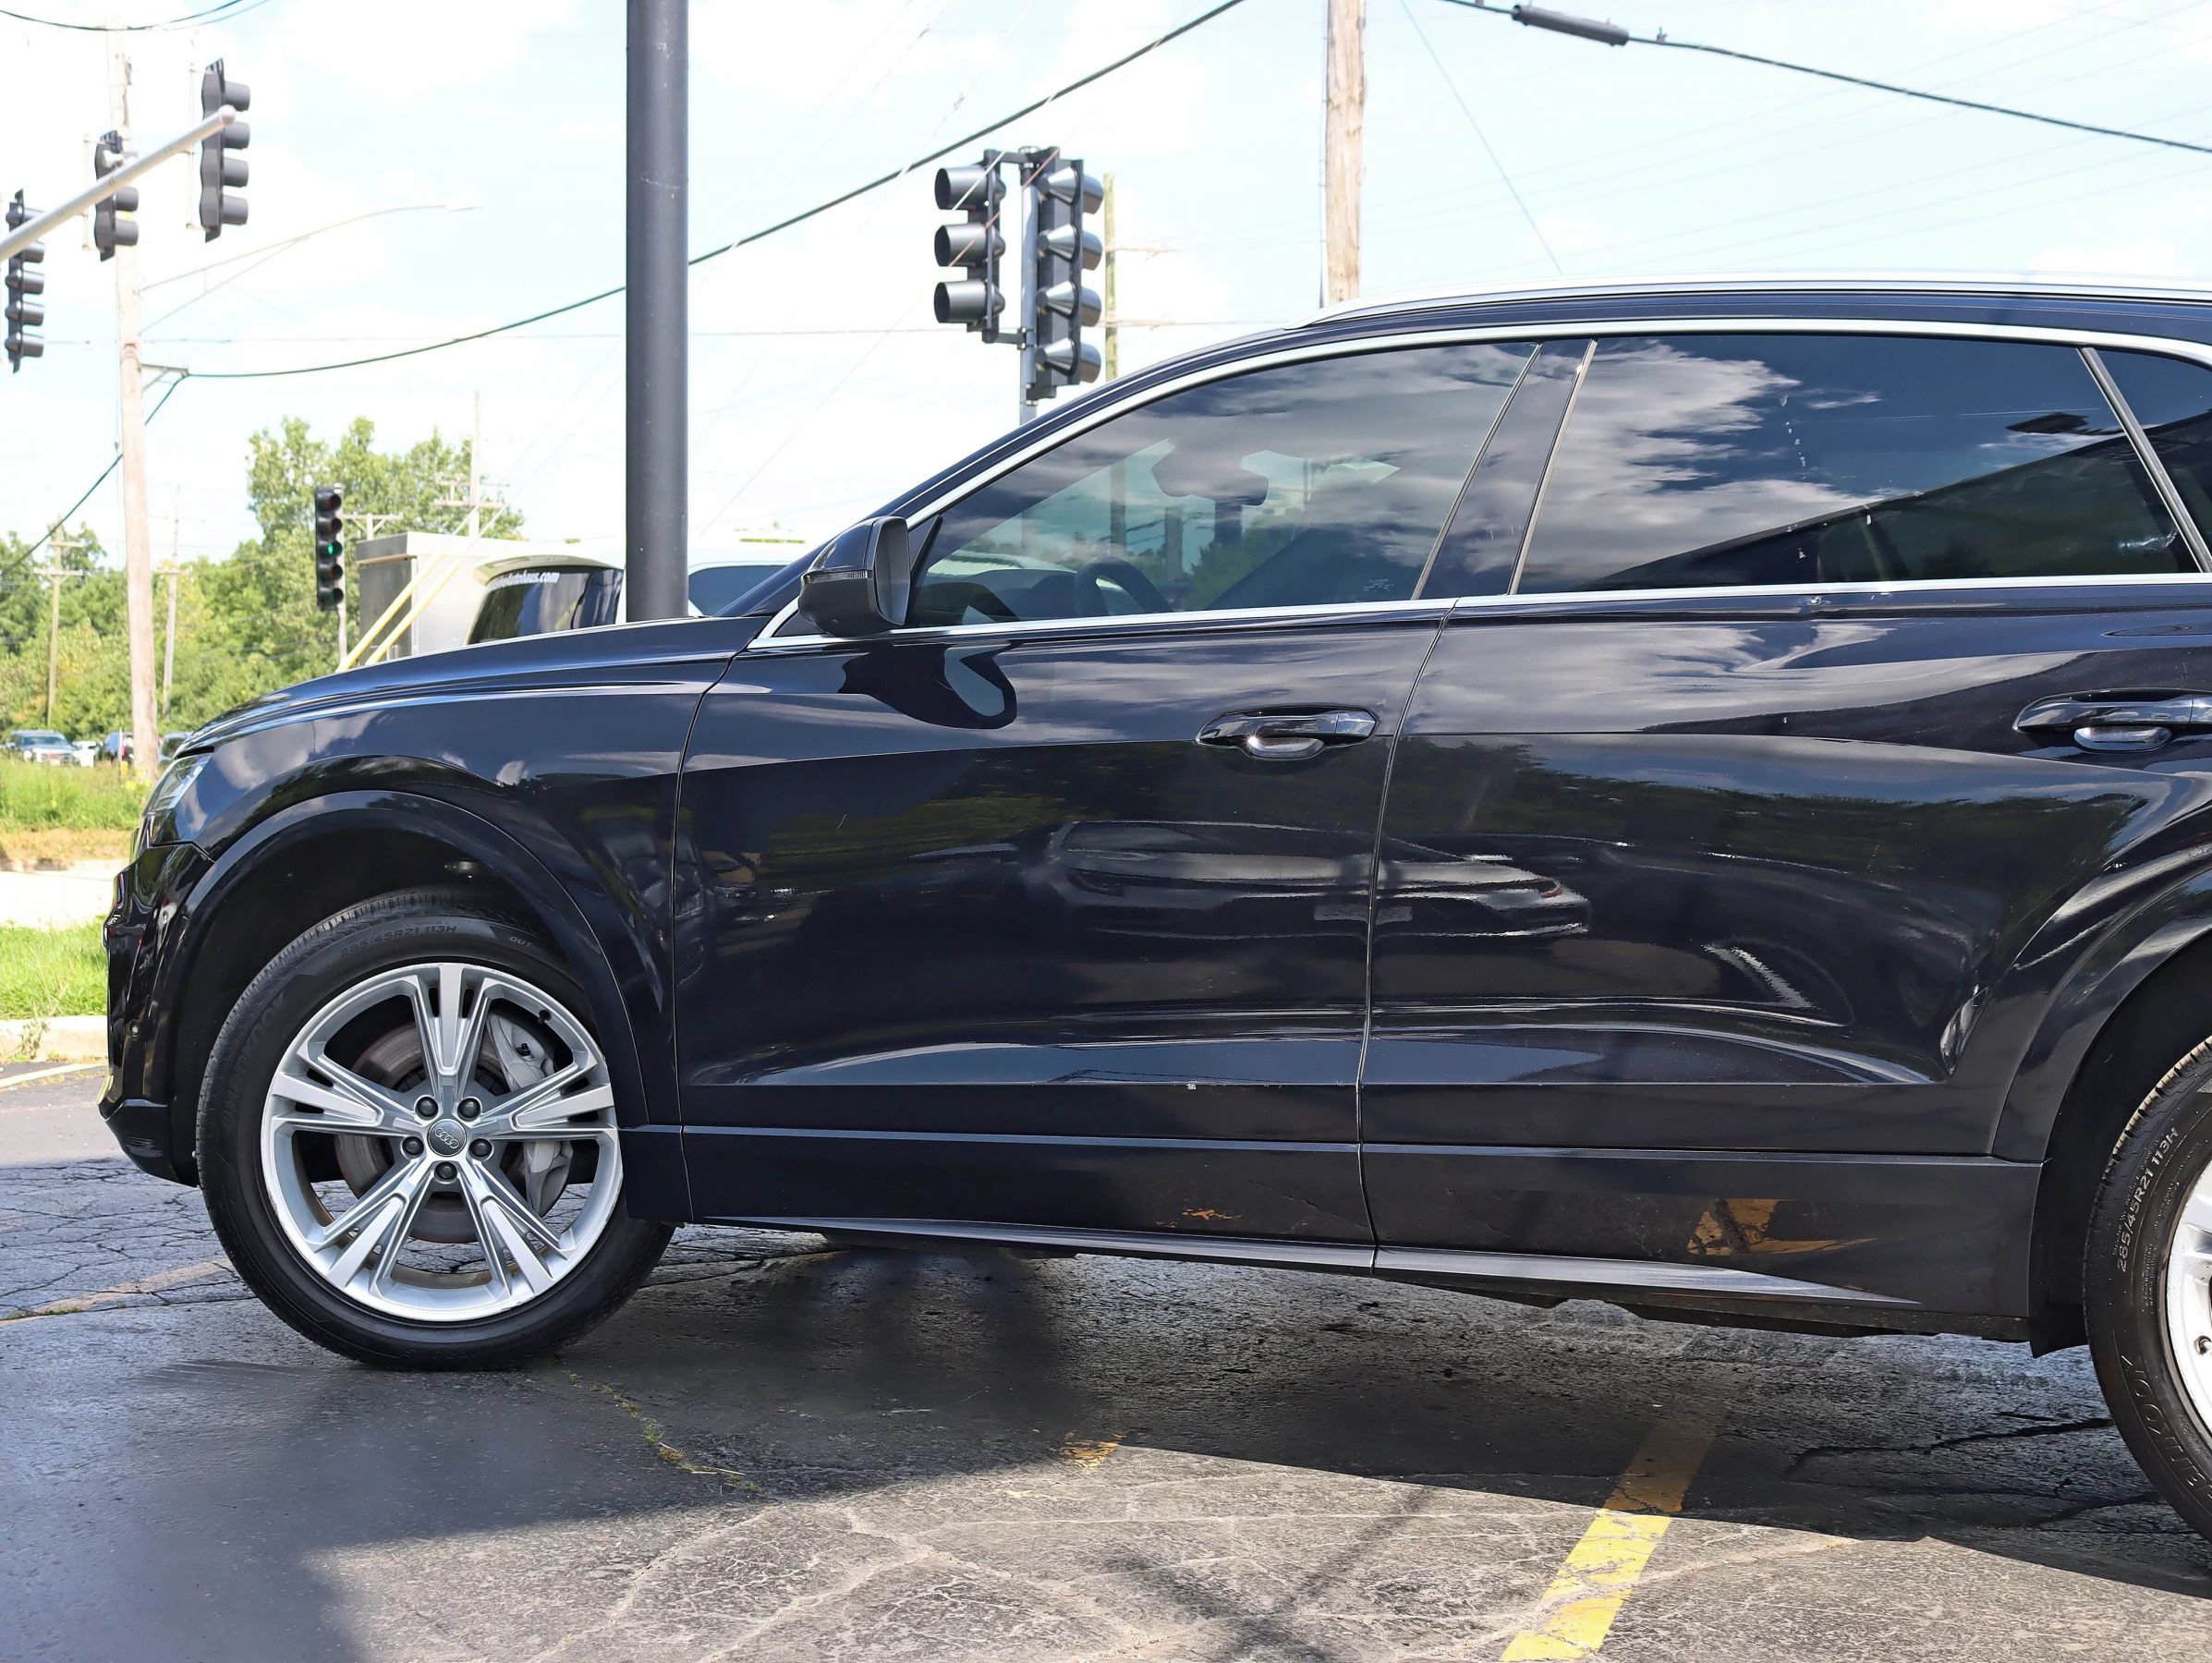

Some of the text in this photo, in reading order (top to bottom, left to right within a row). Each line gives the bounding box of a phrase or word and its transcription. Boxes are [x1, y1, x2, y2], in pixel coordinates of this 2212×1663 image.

[339, 925, 457, 956] 285/45R21 113H
[2117, 1168, 2154, 1272] 285/45R21
[2151, 1127, 2179, 1165] 113H
